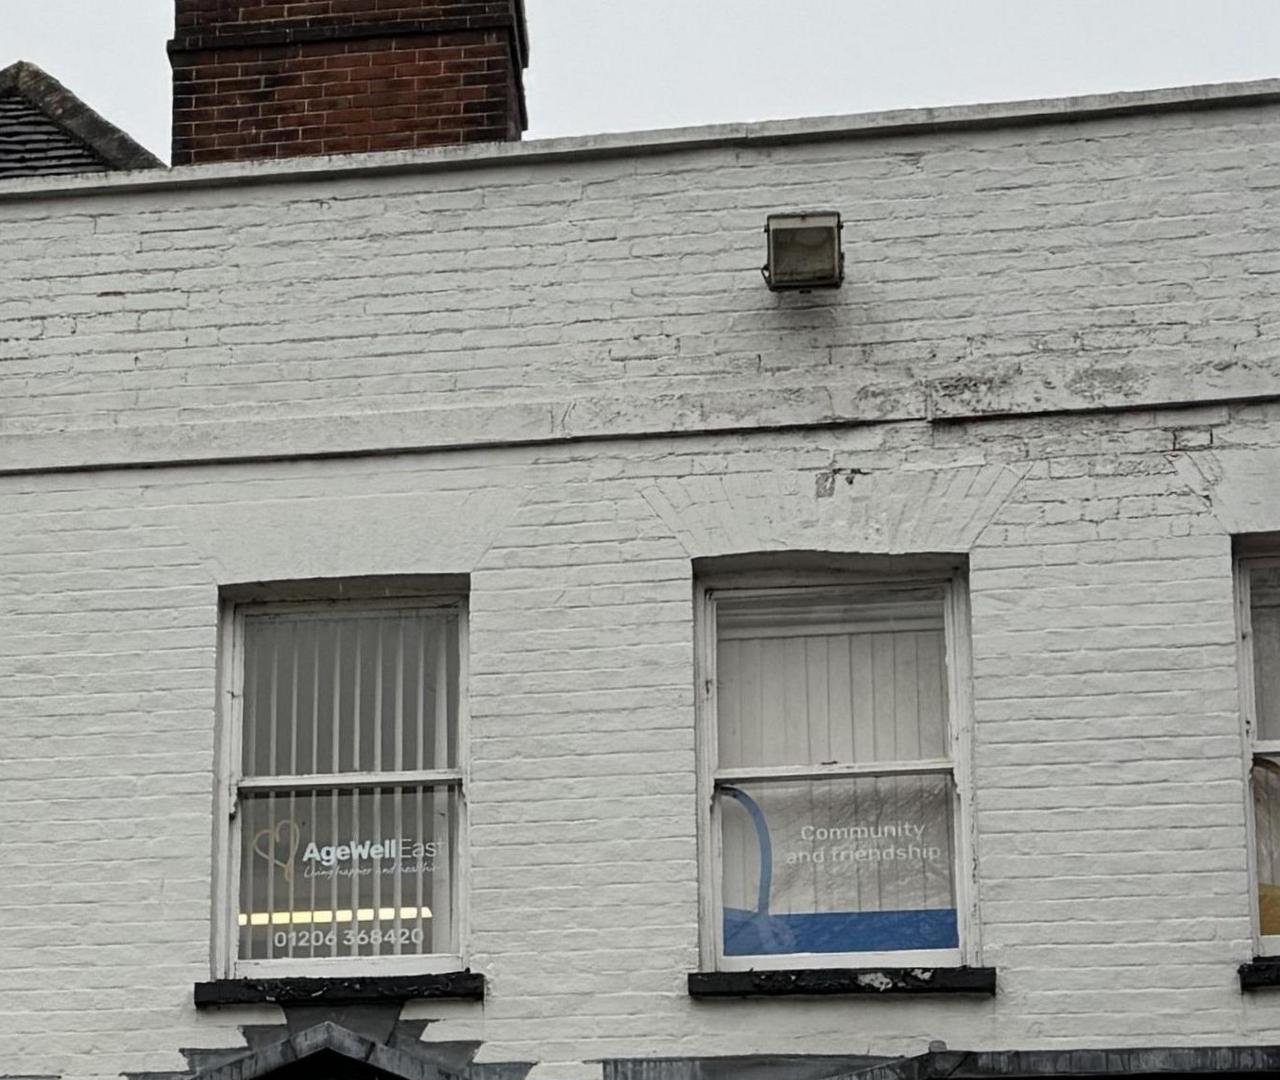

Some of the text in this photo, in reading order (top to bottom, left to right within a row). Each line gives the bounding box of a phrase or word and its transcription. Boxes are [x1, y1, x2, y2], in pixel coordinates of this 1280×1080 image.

[801, 820, 926, 841] Community
[786, 844, 941, 864] and friendship
[274, 928, 424, 947] 01206 368420
